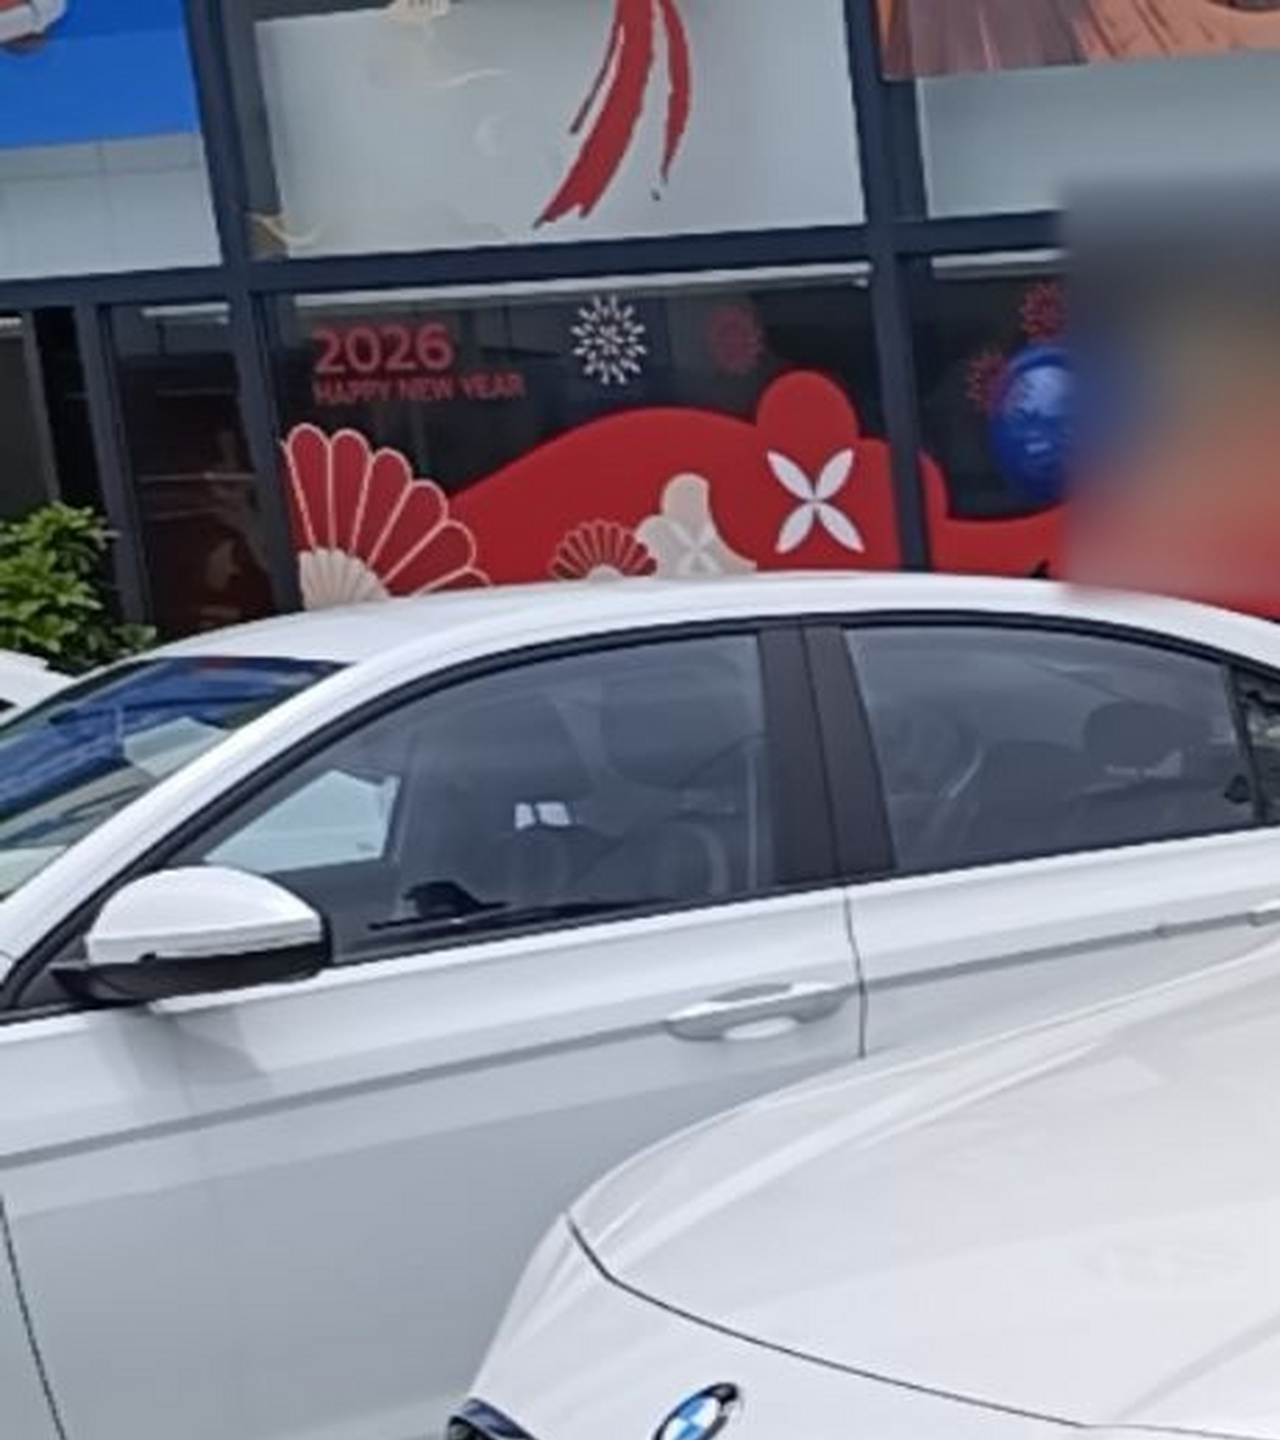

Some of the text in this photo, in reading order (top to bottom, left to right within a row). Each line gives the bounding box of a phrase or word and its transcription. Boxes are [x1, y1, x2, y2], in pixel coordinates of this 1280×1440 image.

[311, 322, 455, 374] 2026
[313, 371, 526, 404] HAPPY NEW YEAR
